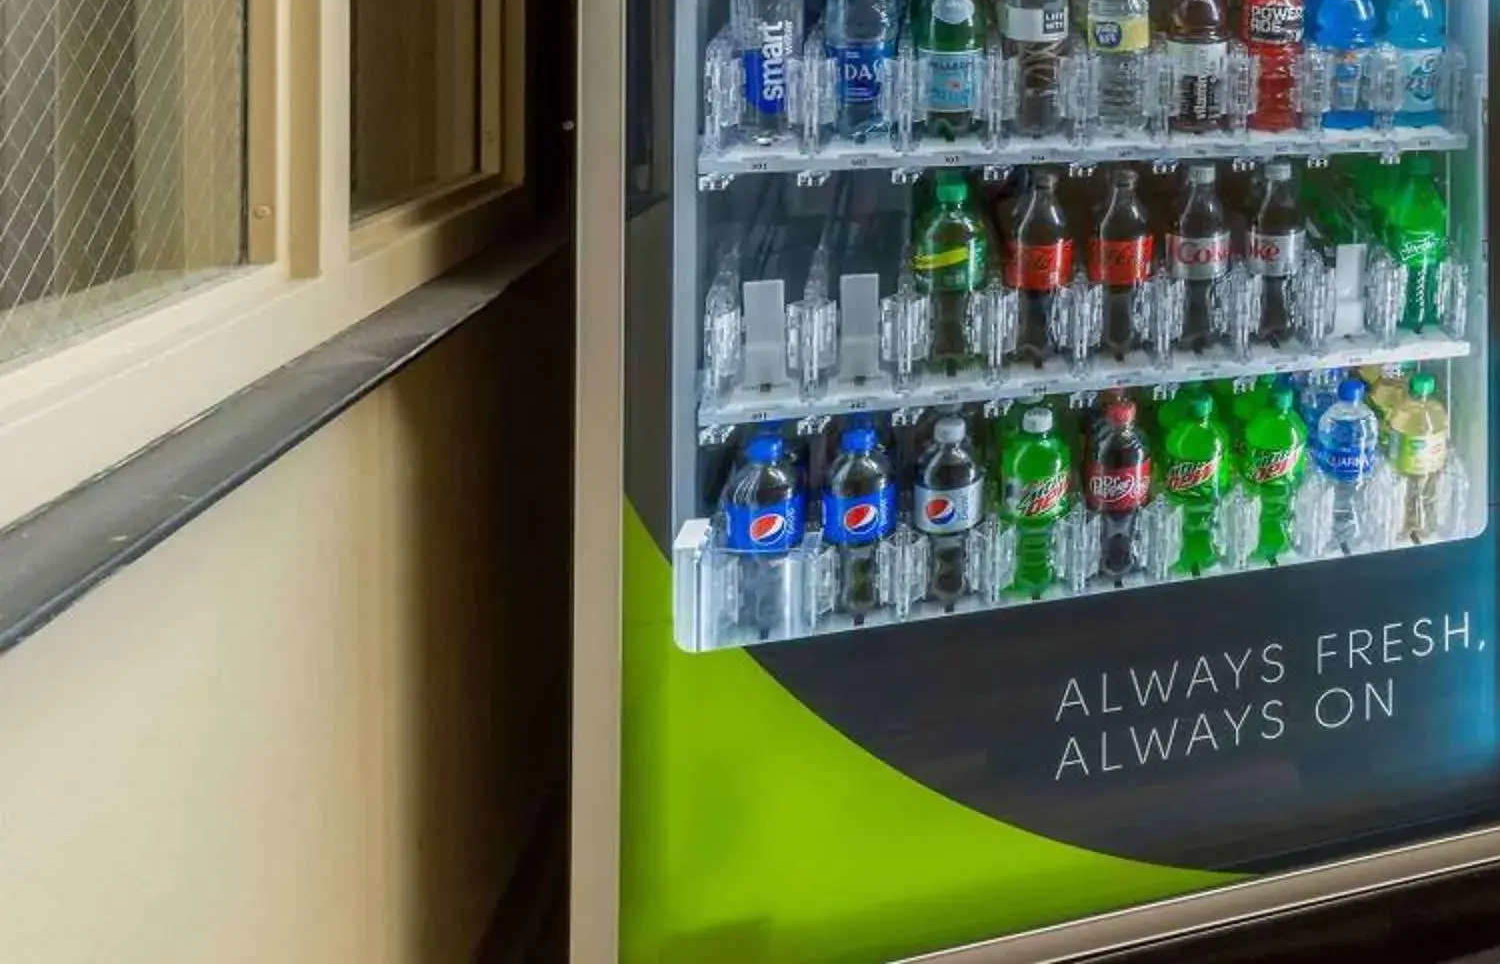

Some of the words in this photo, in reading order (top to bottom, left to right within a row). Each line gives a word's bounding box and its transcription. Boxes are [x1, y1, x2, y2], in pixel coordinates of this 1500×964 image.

[758, 20, 785, 101] smart
[1055, 643, 1286, 722] ALWAYS
[1316, 611, 1487, 674] FRESH,
[1055, 700, 1286, 780] ALWAYS
[1315, 678, 1394, 729] ON
